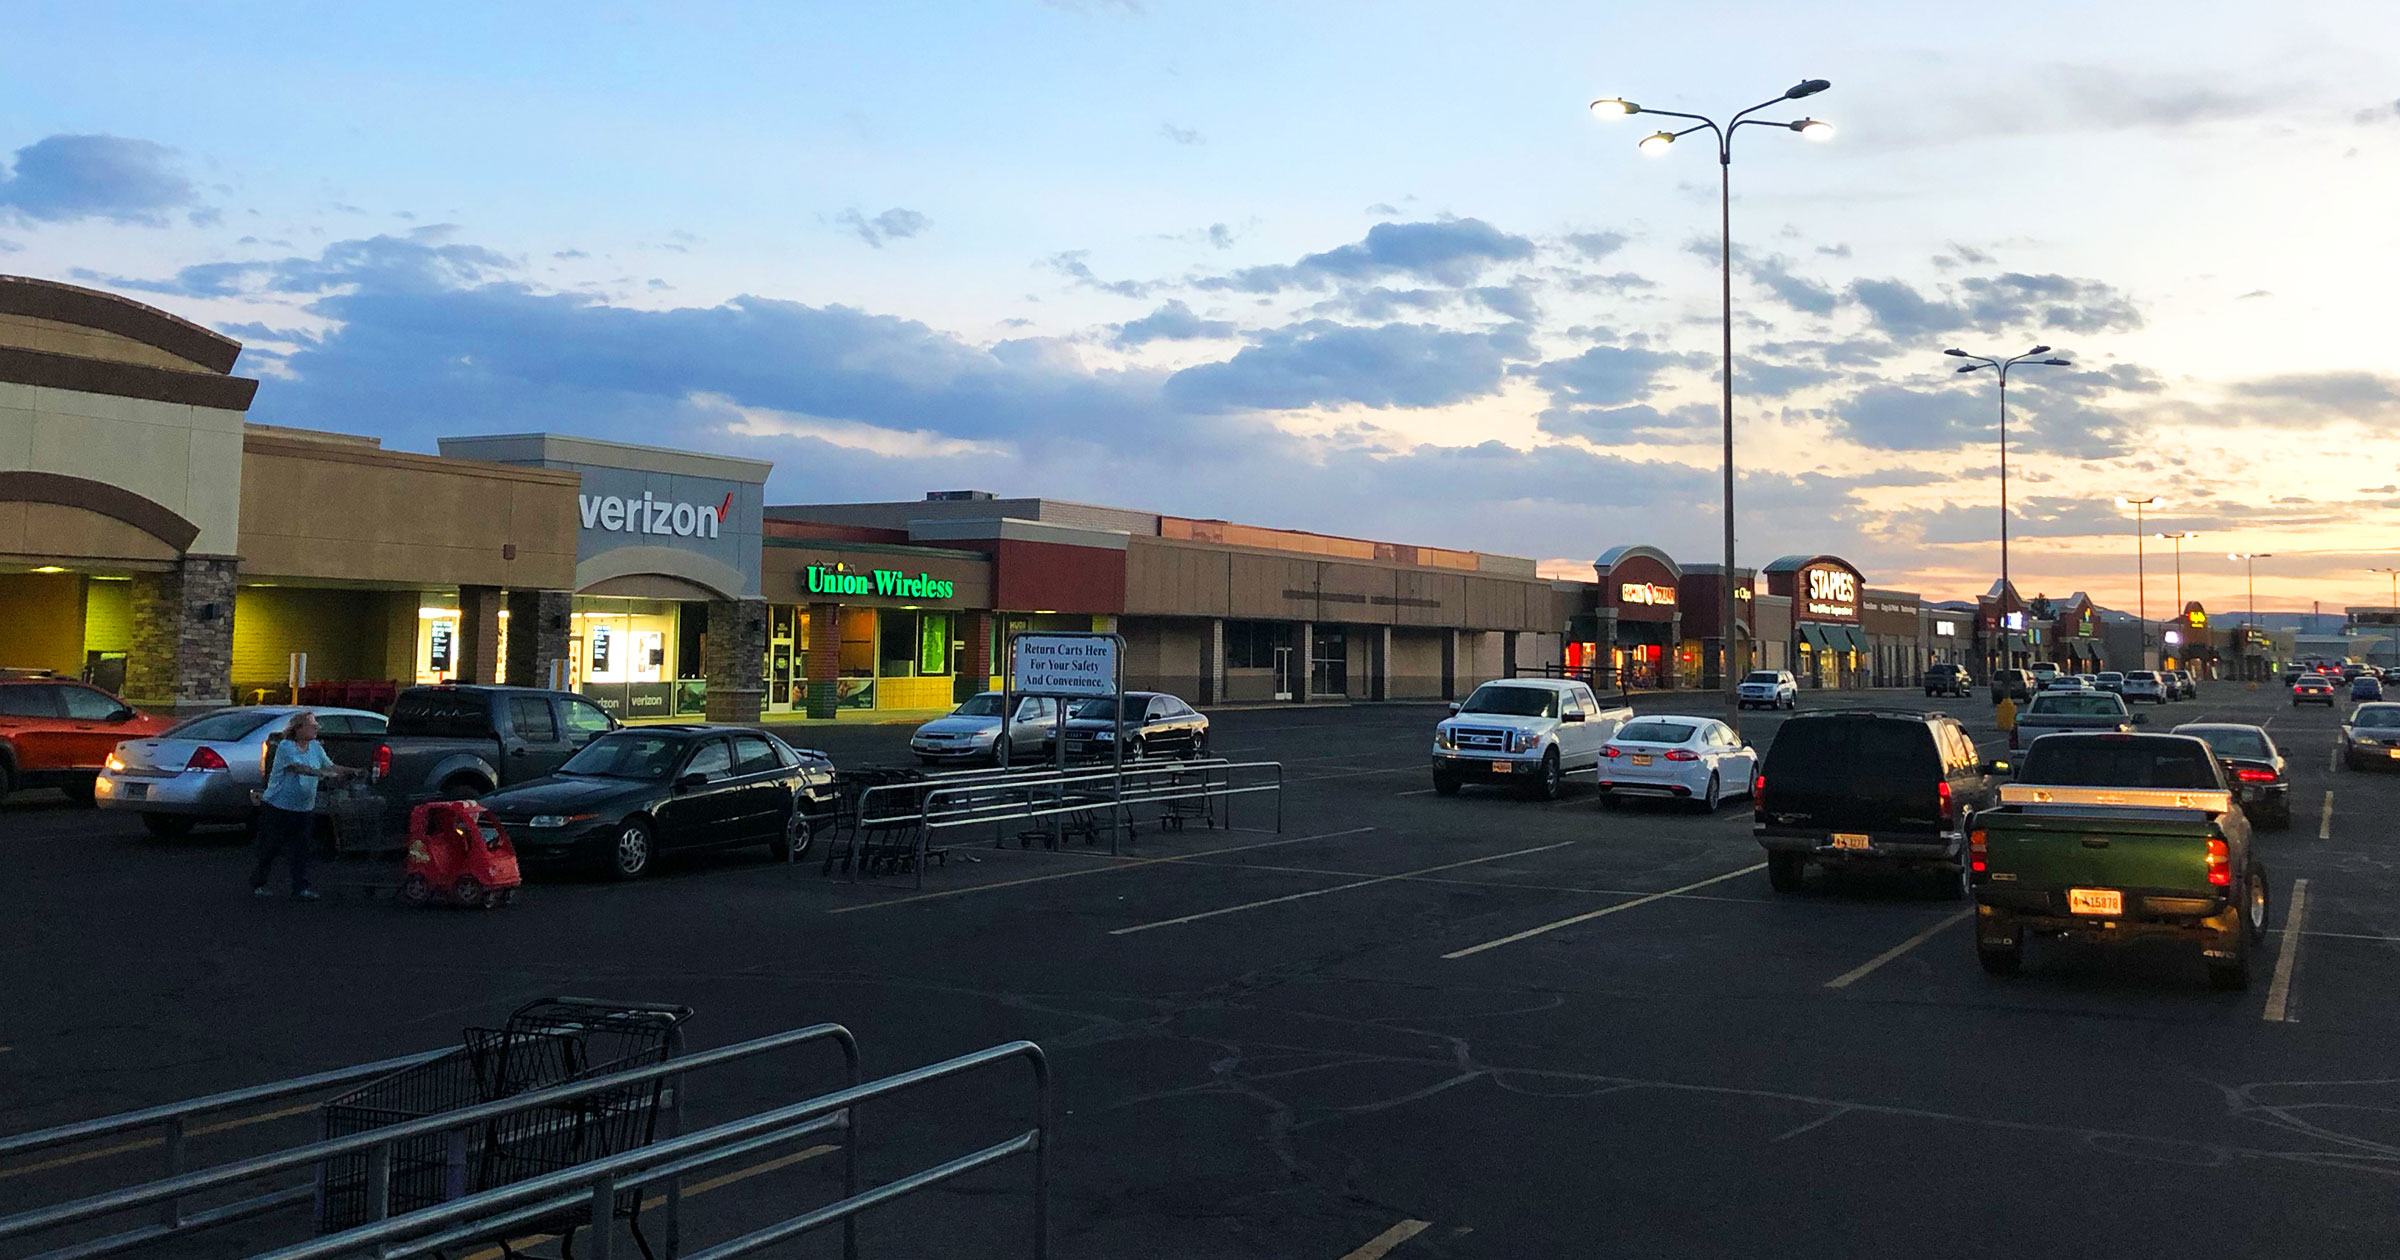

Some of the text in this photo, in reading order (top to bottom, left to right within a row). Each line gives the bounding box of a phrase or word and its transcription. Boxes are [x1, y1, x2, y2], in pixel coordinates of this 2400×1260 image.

[578, 491, 719, 538] verizon
[807, 565, 953, 598] Union Wireless
[1810, 569, 1854, 602] STAPLES
[1025, 643, 1108, 656] Return Carts Here
[1030, 659, 1099, 674] For Your Safety
[1024, 675, 1105, 687] And Convenience.
[631, 694, 662, 706] verizon
[2090, 897, 2118, 909] 15878
